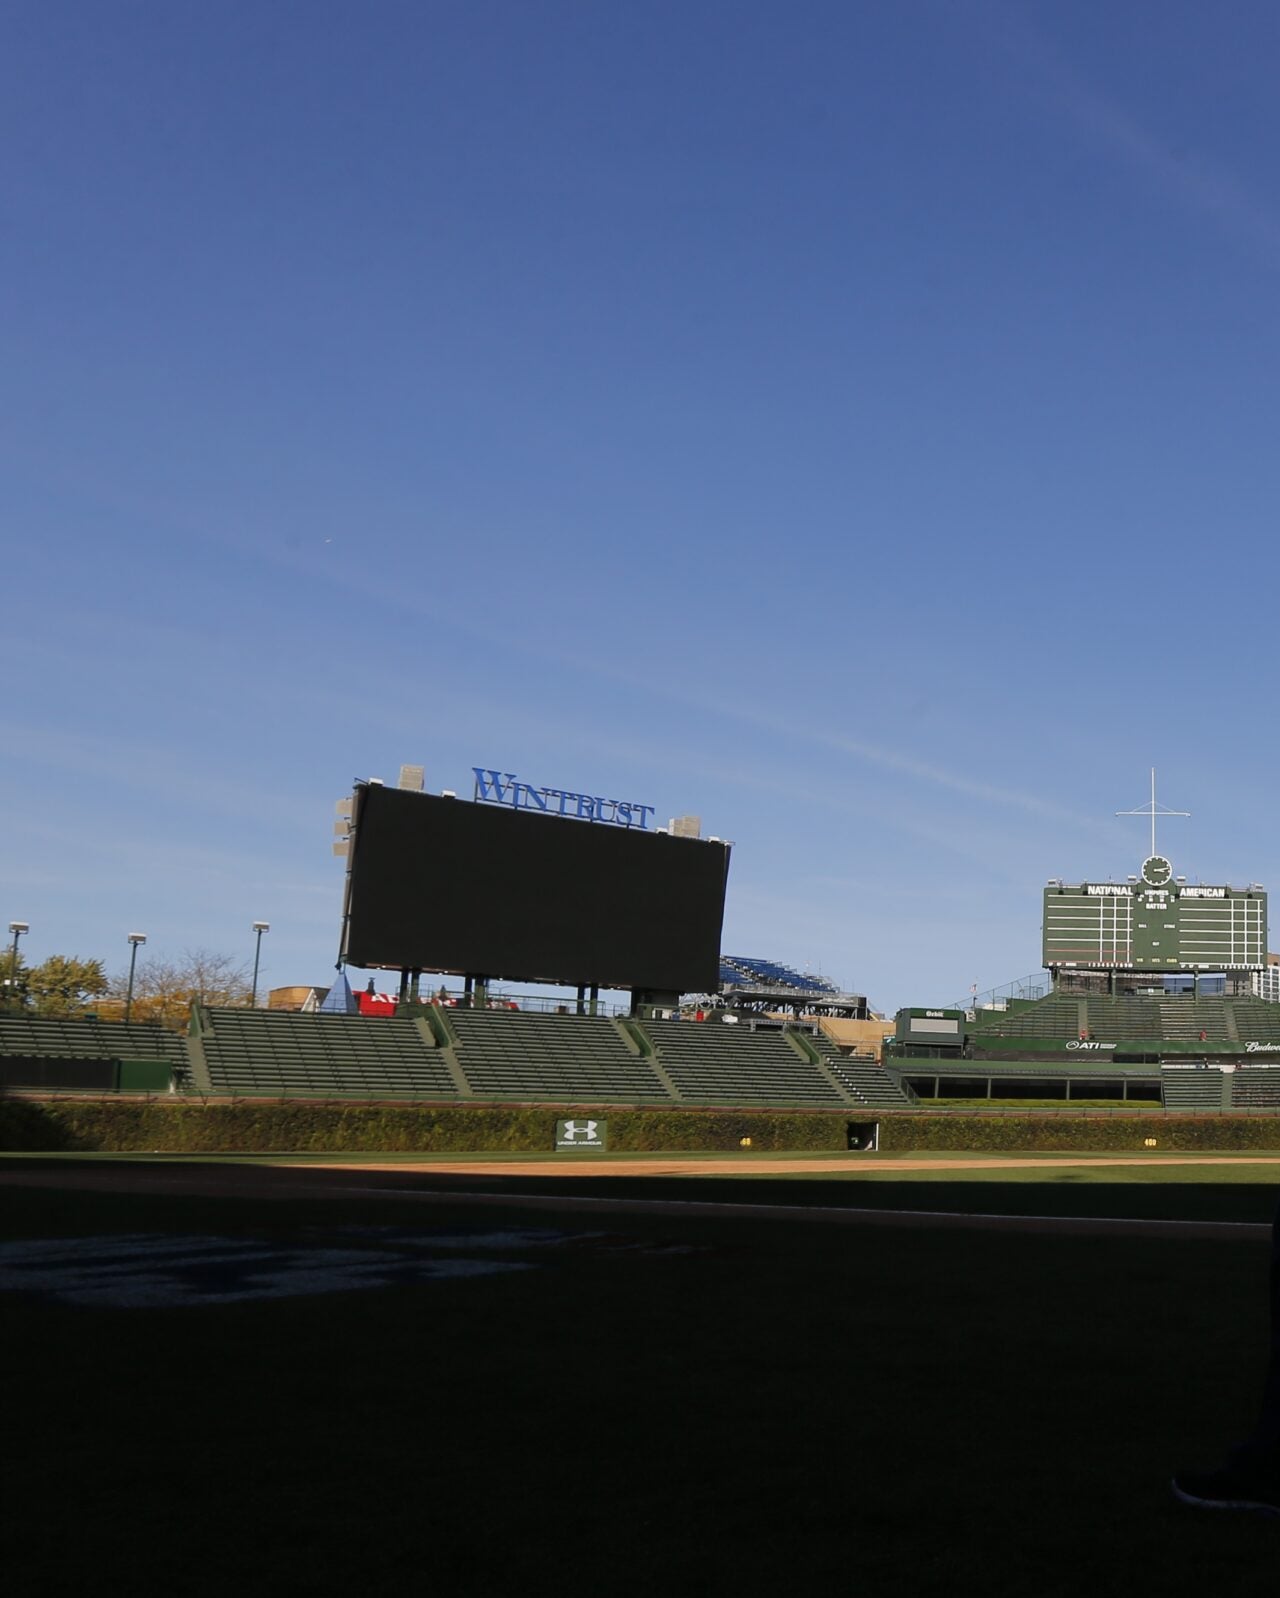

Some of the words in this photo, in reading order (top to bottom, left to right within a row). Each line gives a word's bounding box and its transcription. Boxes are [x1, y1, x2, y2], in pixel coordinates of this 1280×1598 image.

[471, 767, 655, 829] WINTRUST
[1087, 885, 1134, 896] NATIONAL
[1179, 887, 1225, 899] AMERICAN
[1145, 902, 1167, 910] BATTER
[926, 1010, 944, 1018] Orbit
[1079, 1042, 1100, 1050] ATI
